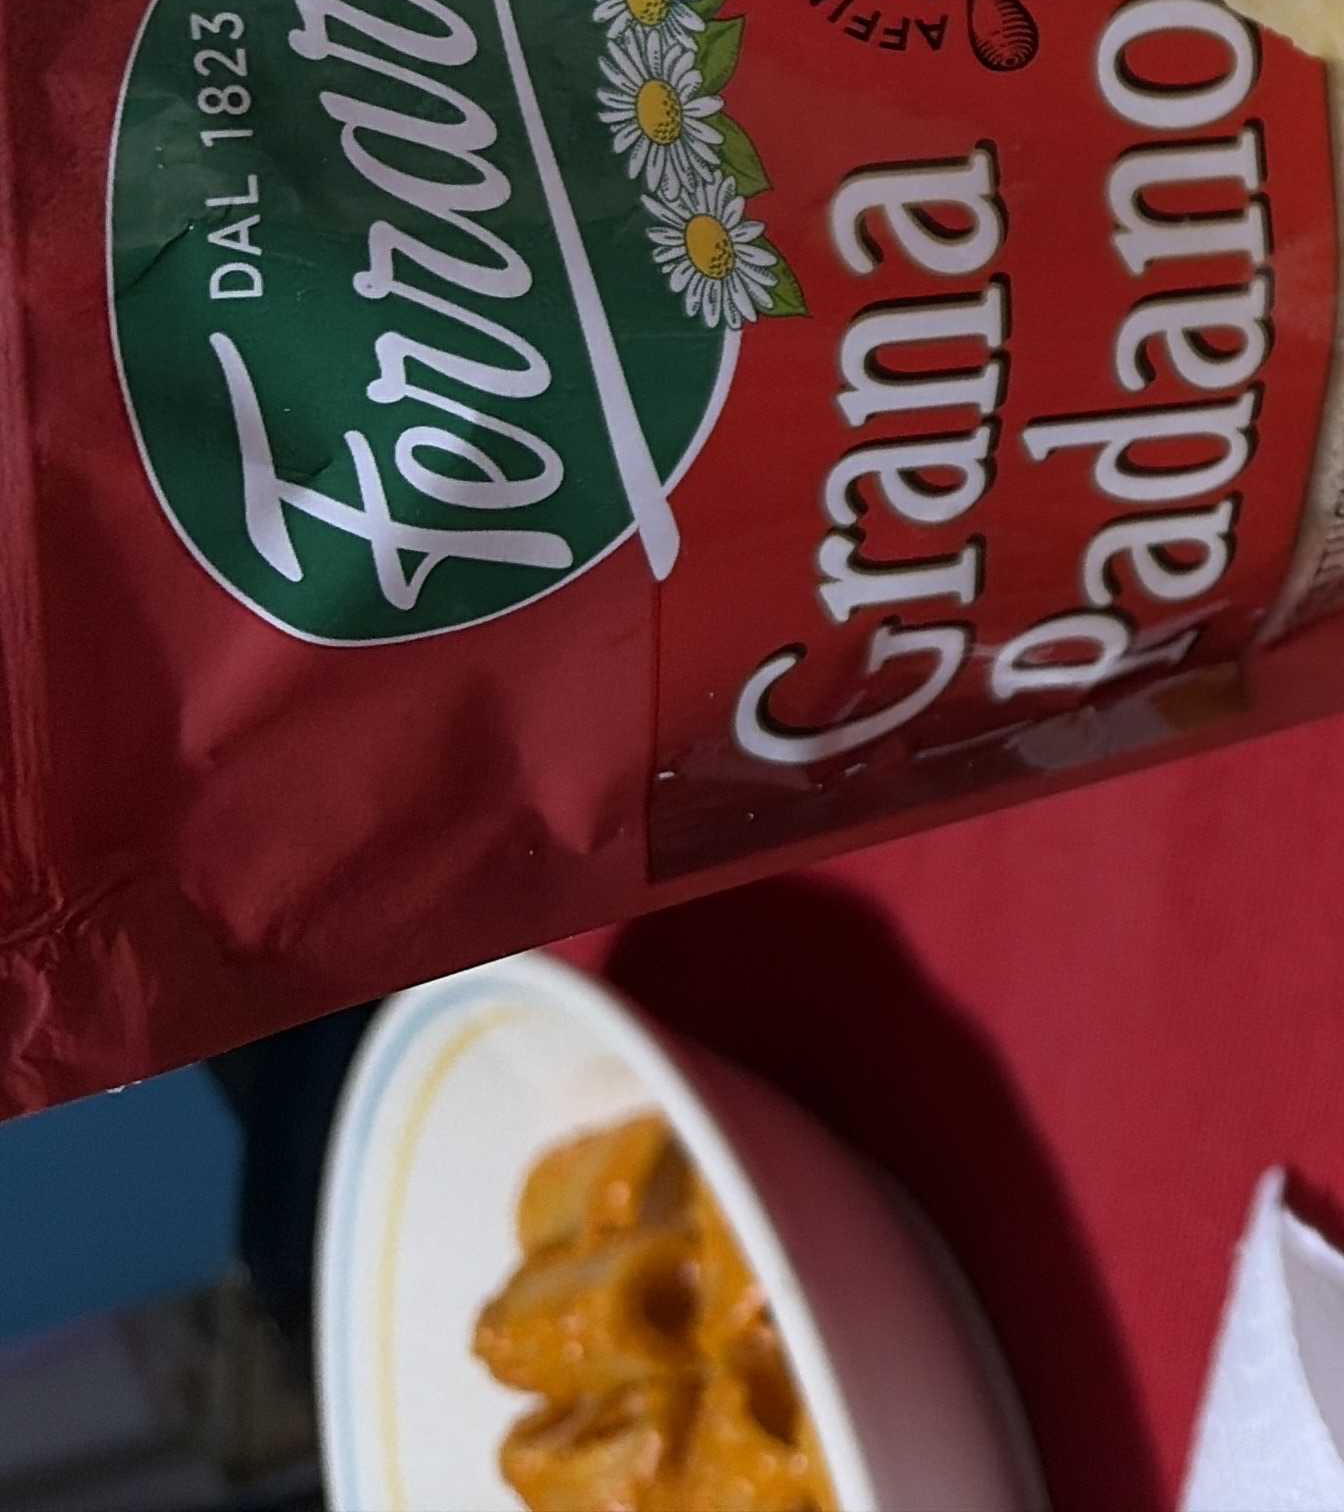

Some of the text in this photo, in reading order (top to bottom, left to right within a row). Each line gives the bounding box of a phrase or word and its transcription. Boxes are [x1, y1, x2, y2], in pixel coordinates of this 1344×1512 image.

[189, 6, 266, 301] DAL 1823
[733, 146, 1012, 766] Grana
